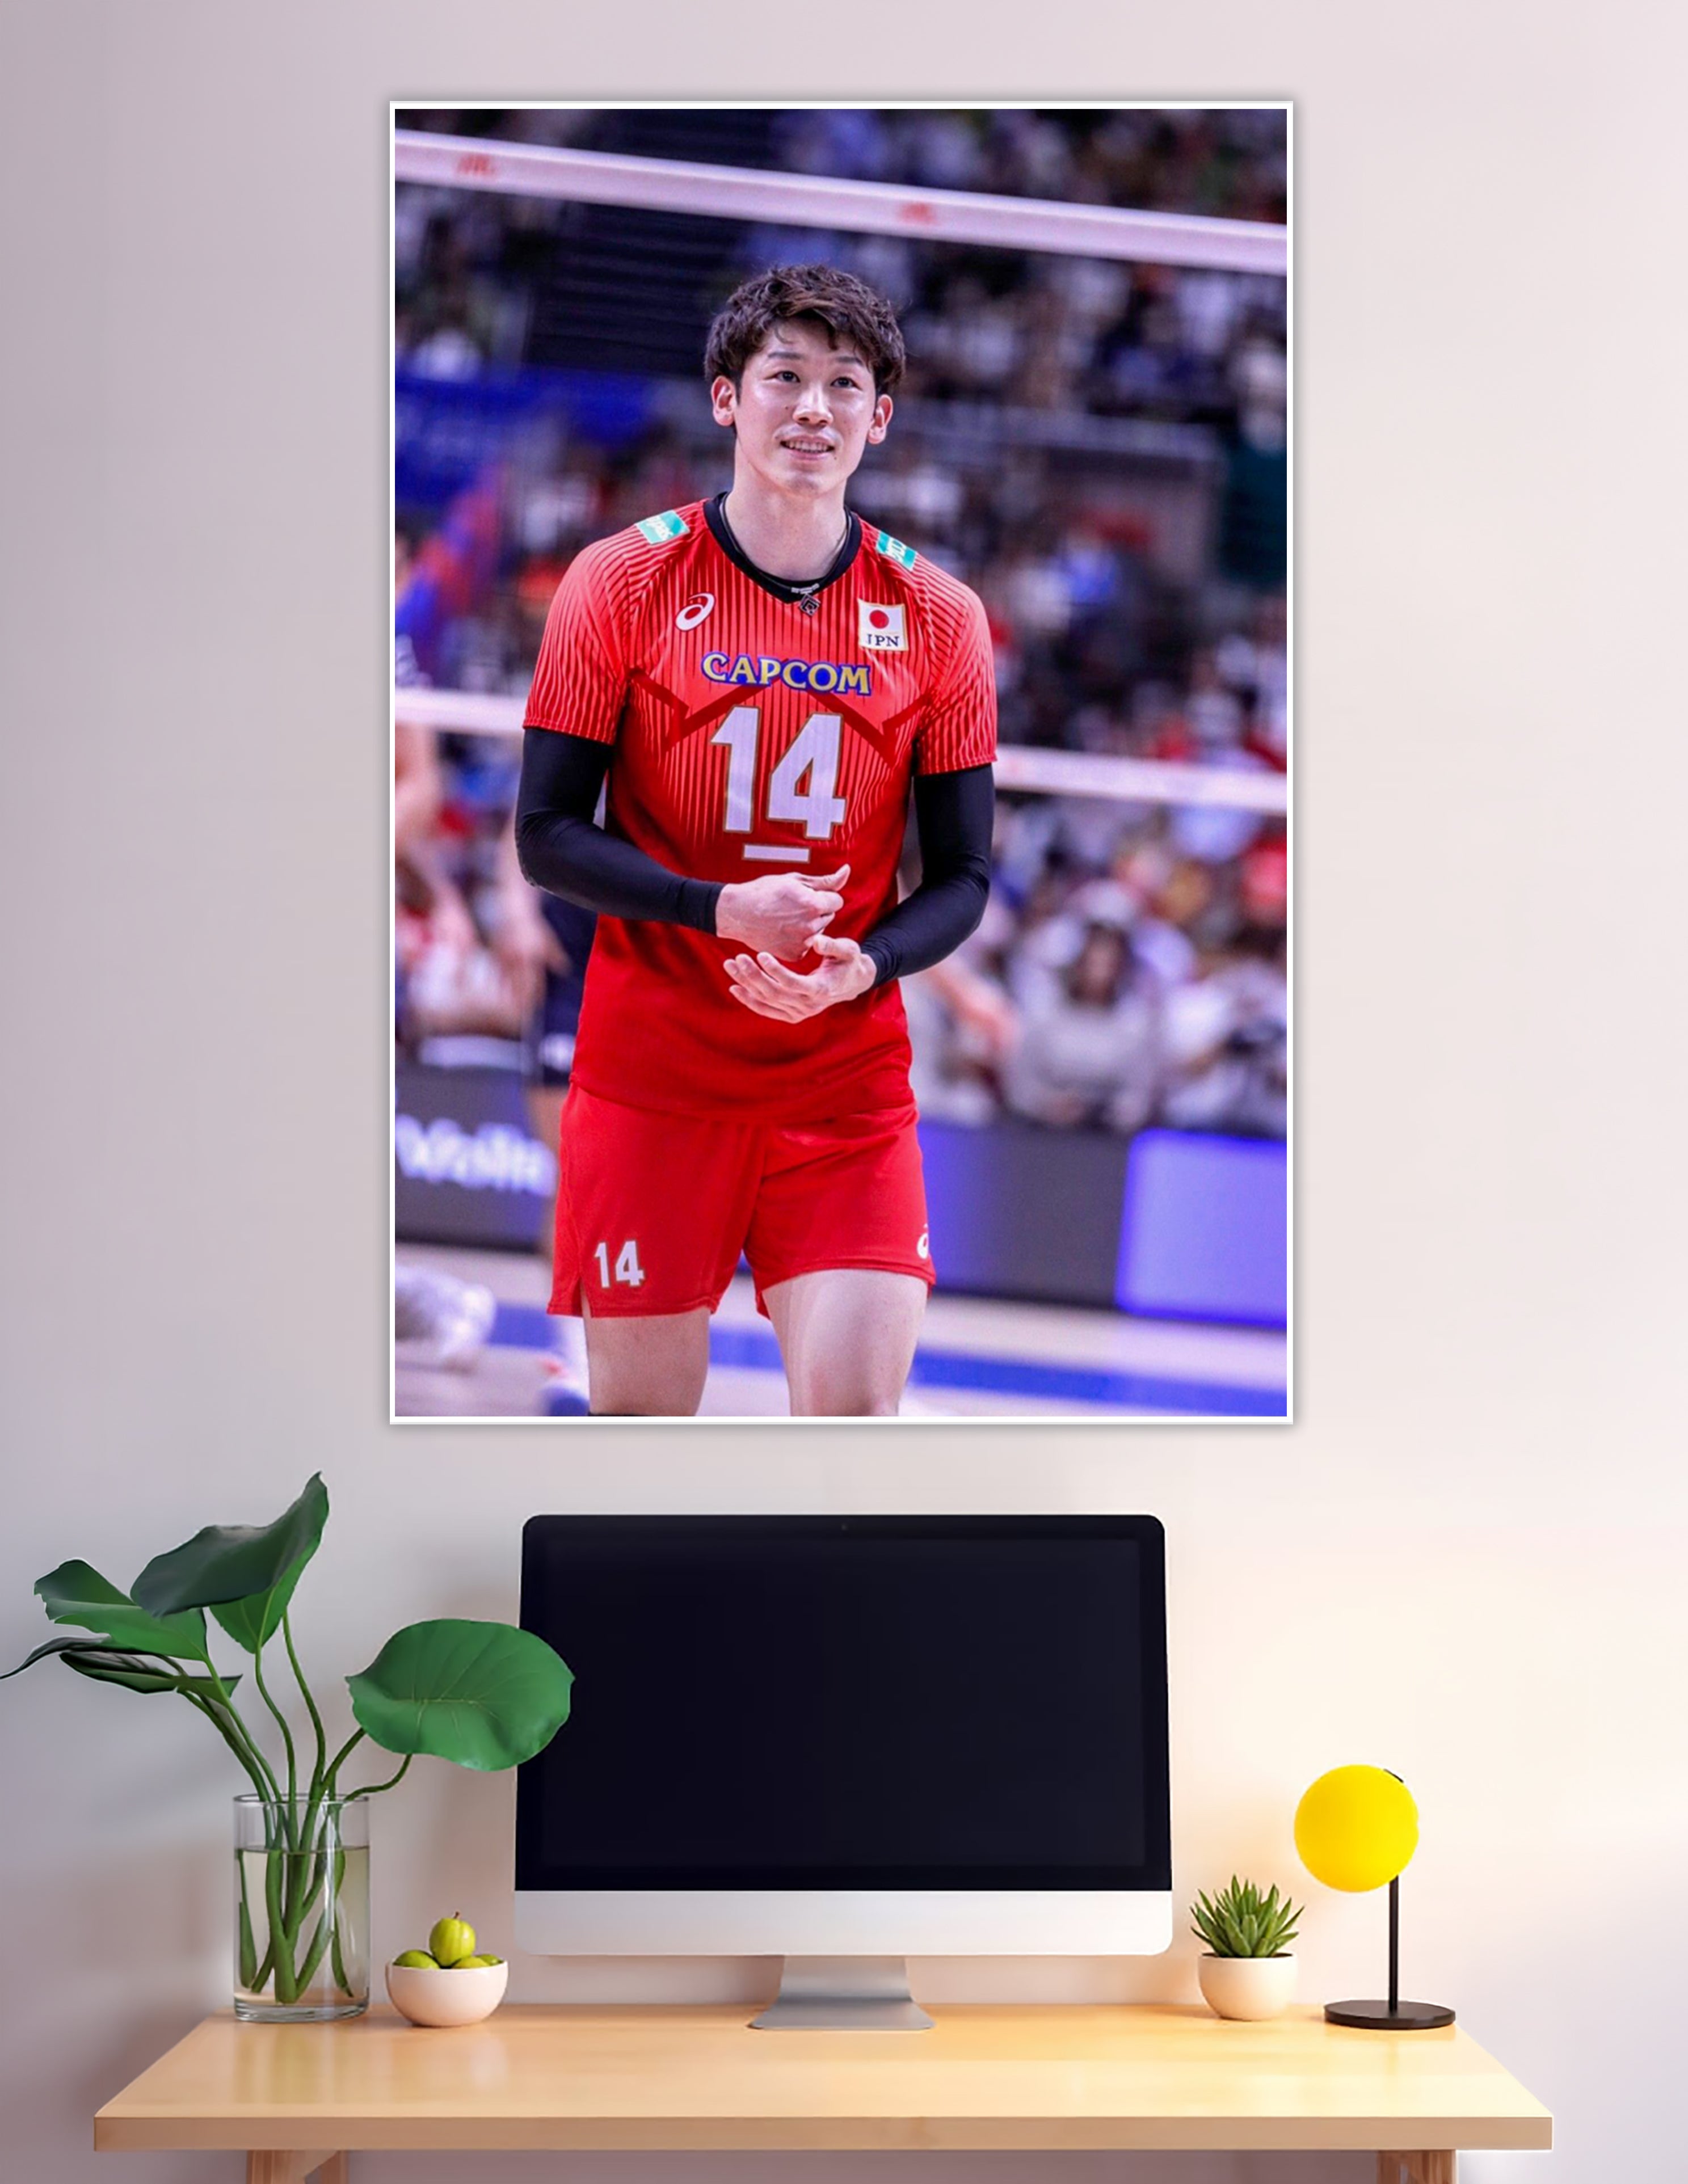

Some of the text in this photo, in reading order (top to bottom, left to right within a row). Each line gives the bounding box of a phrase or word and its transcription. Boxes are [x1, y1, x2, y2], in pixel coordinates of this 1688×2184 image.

[701, 652, 872, 695] CAPCOM
[710, 706, 846, 840] 14
[594, 1240, 645, 1288] 14
